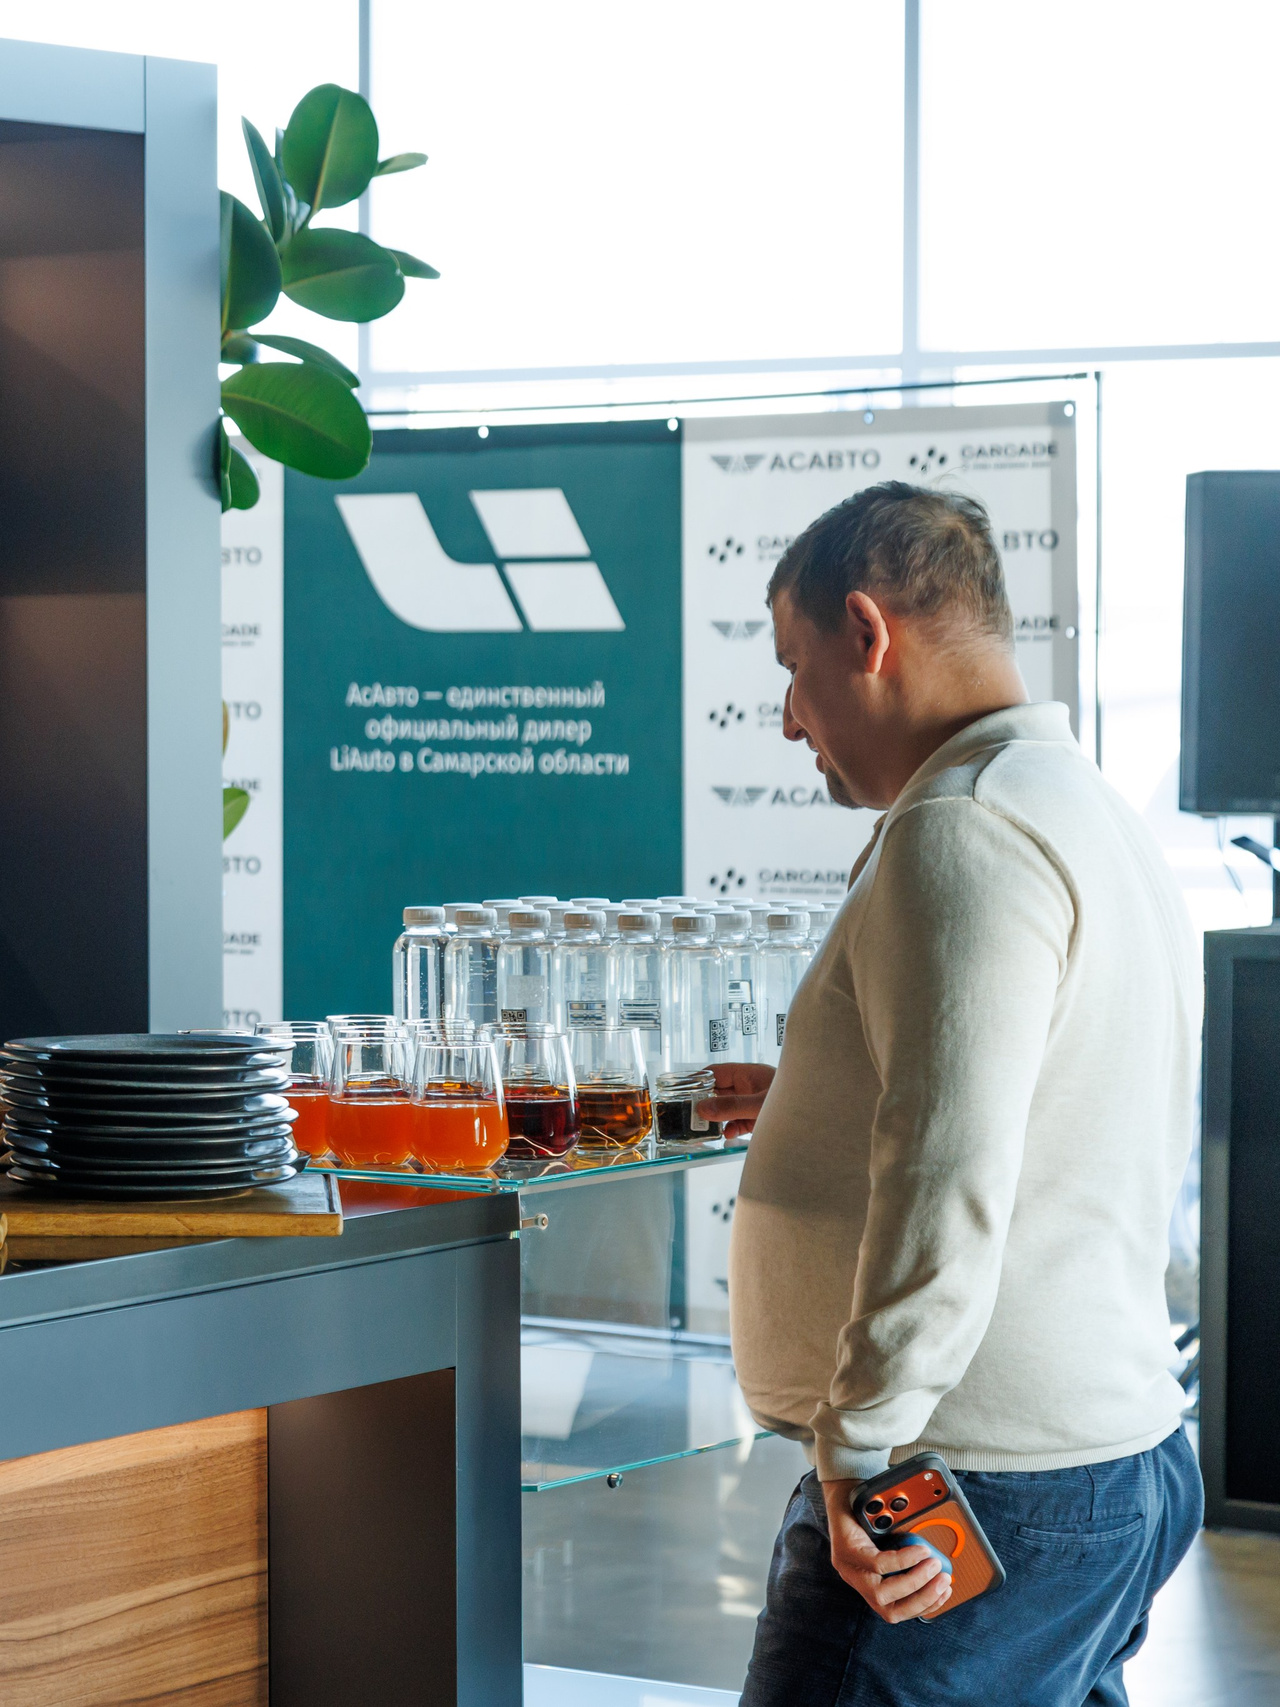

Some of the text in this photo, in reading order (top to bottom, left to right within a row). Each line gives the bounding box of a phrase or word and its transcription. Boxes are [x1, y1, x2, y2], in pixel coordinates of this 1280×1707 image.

[770, 449, 881, 472] АСАВТО
[345, 681, 420, 708] АсАвто
[445, 680, 605, 711] единственный
[365, 713, 592, 747] официальный дилер
[330, 744, 630, 779] LiAuto в Самарской области
